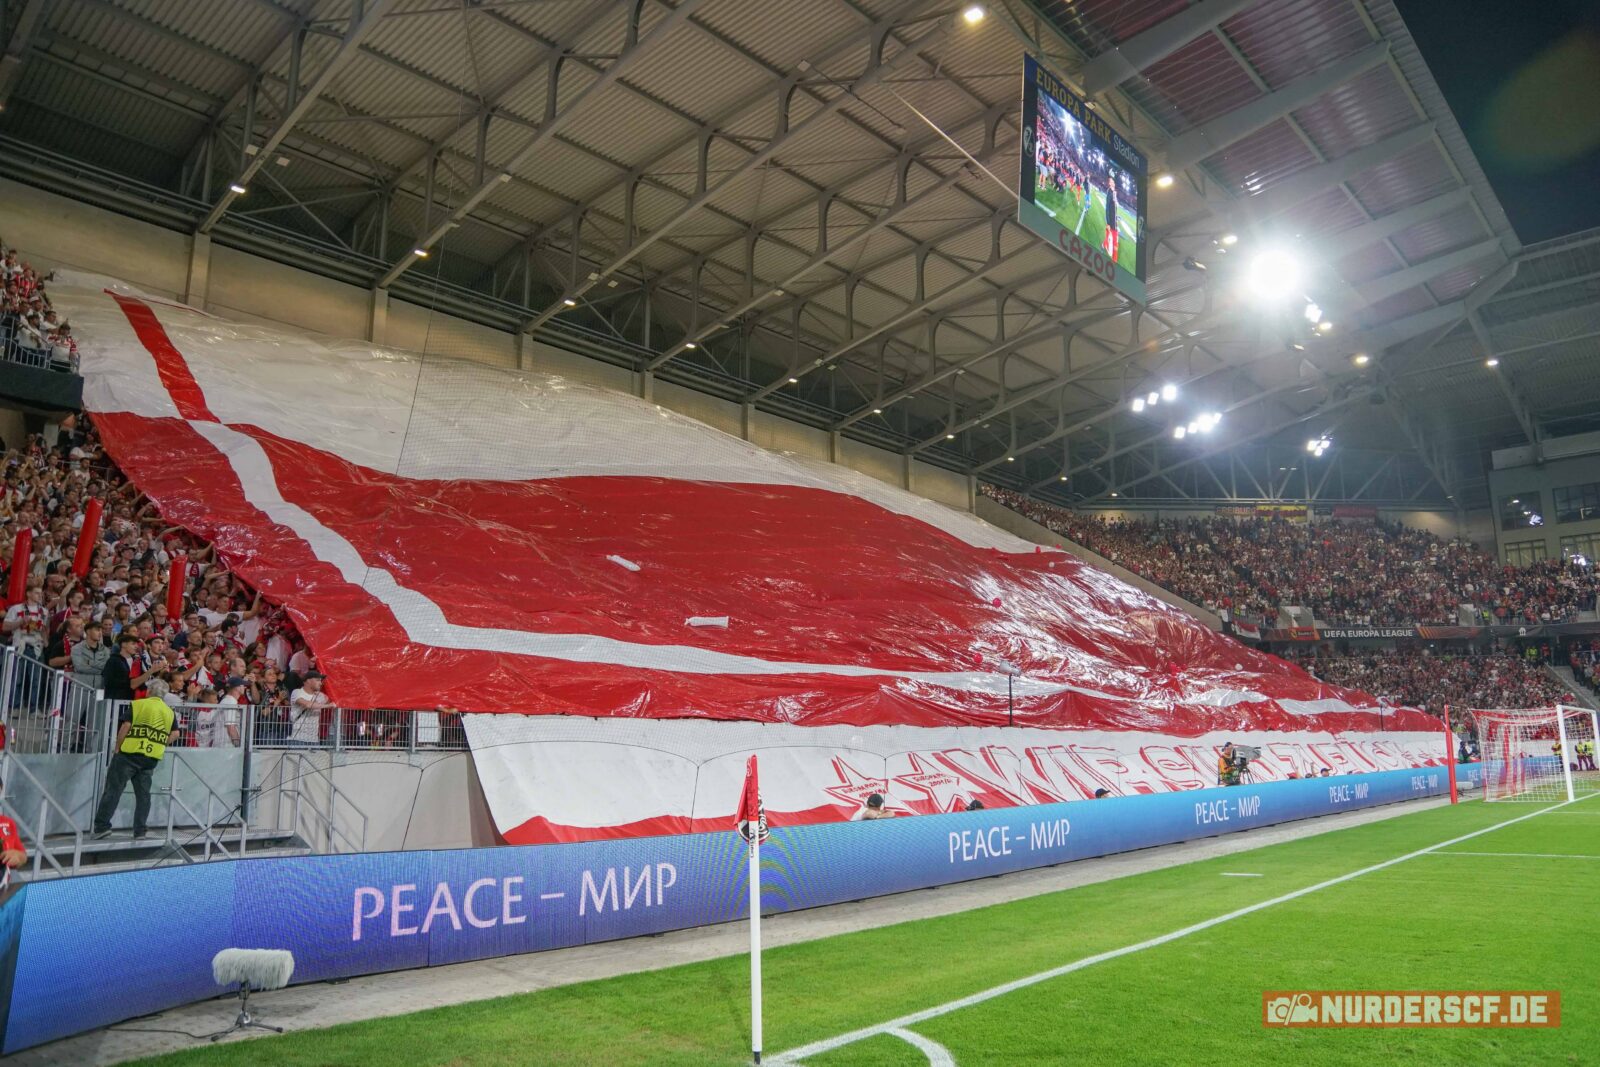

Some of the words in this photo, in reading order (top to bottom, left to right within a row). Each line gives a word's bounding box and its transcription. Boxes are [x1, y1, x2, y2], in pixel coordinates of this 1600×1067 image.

[1036, 70, 1080, 118] EUROPA
[1084, 106, 1111, 145] PARK
[1113, 134, 1140, 169] Stadion
[1059, 229, 1115, 282] CAZOO
[1324, 629, 1346, 638] UEFA
[1347, 629, 1379, 638] EUROPA
[1381, 628, 1413, 637] LEAGUE
[139, 740, 153, 753] 16
[1329, 785, 1349, 803] PEACE
[1355, 783, 1369, 799] МИР
[1411, 775, 1425, 790] PEACE
[1195, 800, 1230, 825] PEACE
[1238, 796, 1261, 818] МИР
[948, 825, 1012, 864] PEACE
[1030, 818, 1071, 851] МИР
[352, 875, 527, 941] PEACE
[579, 862, 677, 916] МИР
